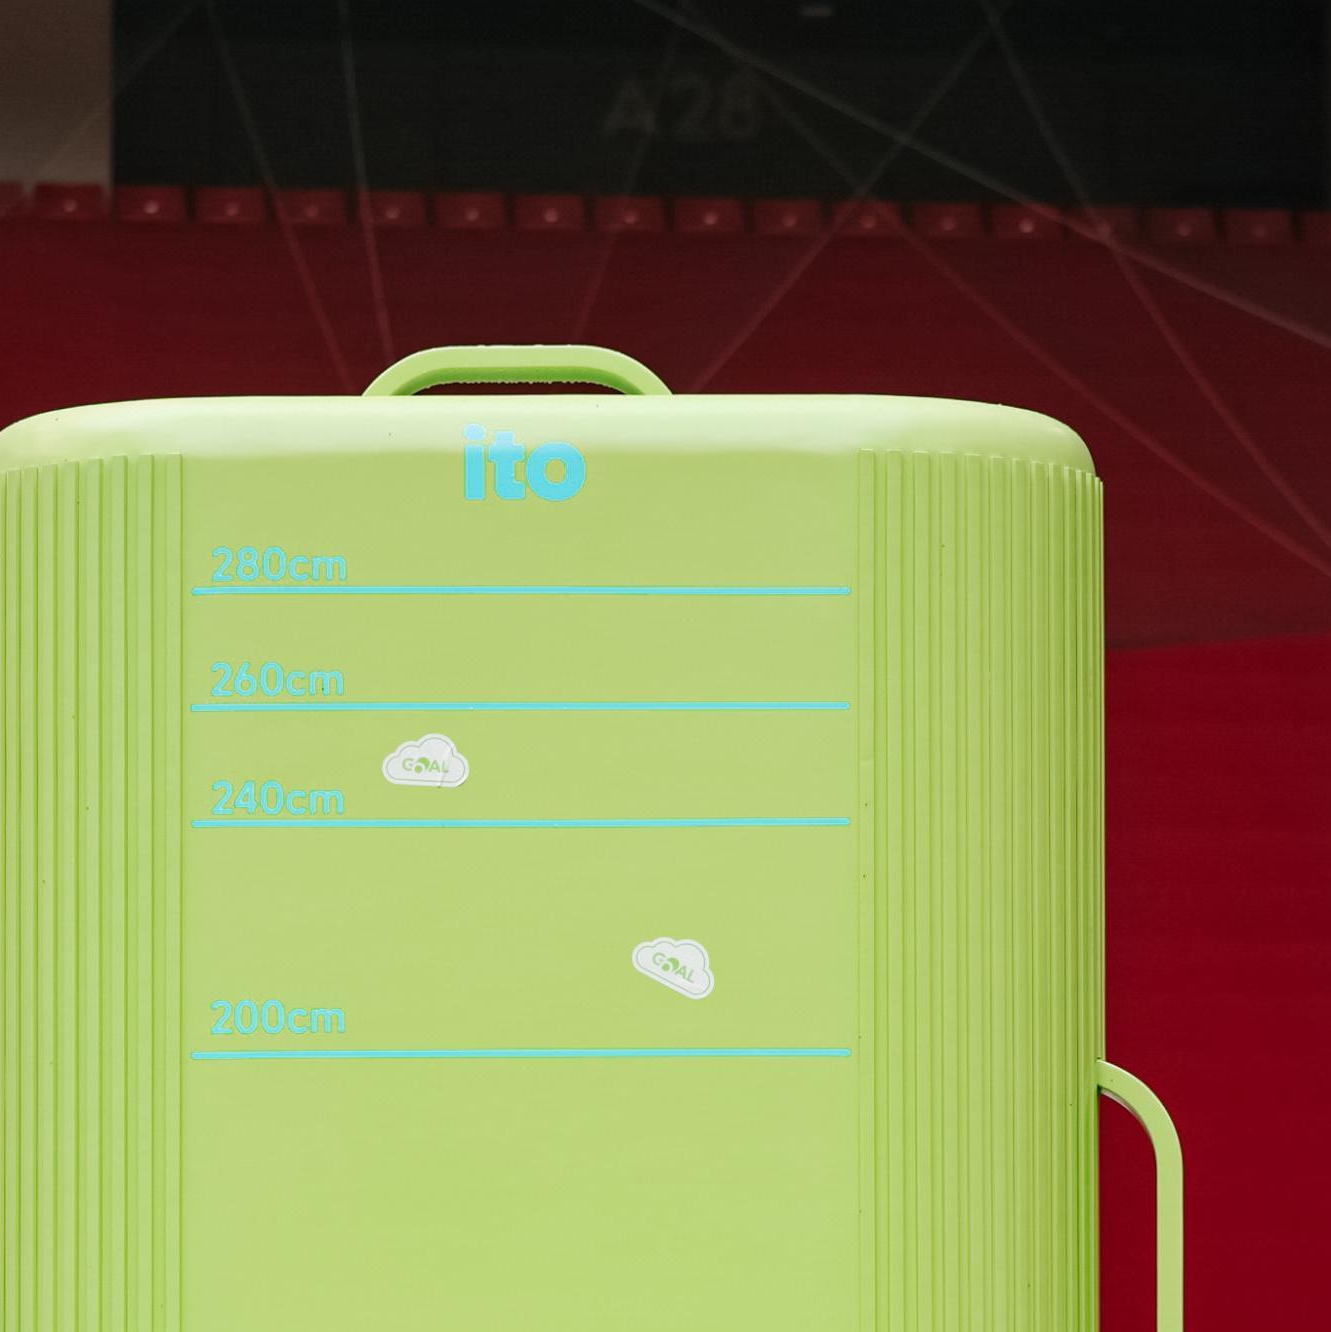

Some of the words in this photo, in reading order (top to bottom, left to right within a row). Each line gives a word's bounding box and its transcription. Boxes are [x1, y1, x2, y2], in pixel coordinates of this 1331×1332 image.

[463, 423, 587, 501] ito
[210, 546, 348, 583] 280cm
[210, 662, 345, 697] 260cm
[210, 780, 345, 816] 240cm
[210, 1000, 346, 1036] 200cm
